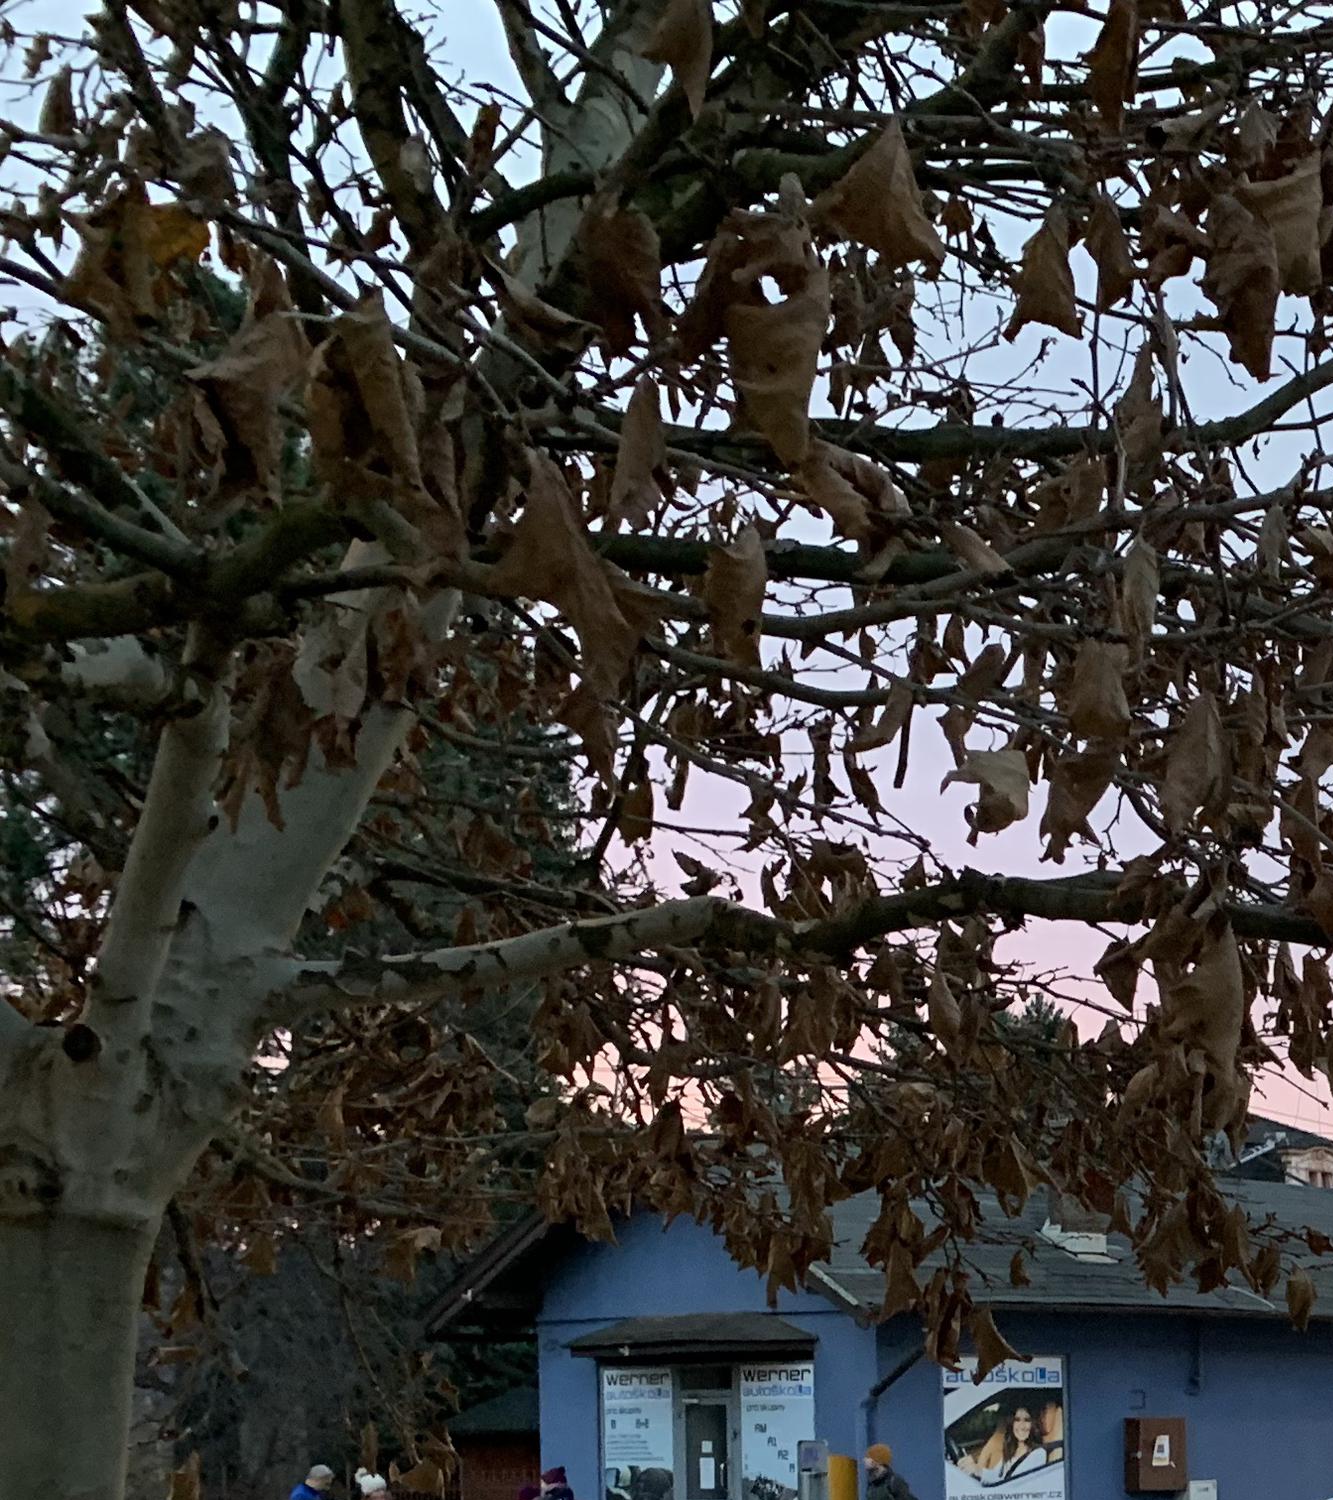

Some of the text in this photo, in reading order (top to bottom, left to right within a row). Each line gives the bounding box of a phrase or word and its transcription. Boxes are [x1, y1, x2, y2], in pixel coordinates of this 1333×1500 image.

[606, 1372, 670, 1387] werner
[743, 1368, 812, 1383] werner
[777, 1450, 789, 1460] A2
